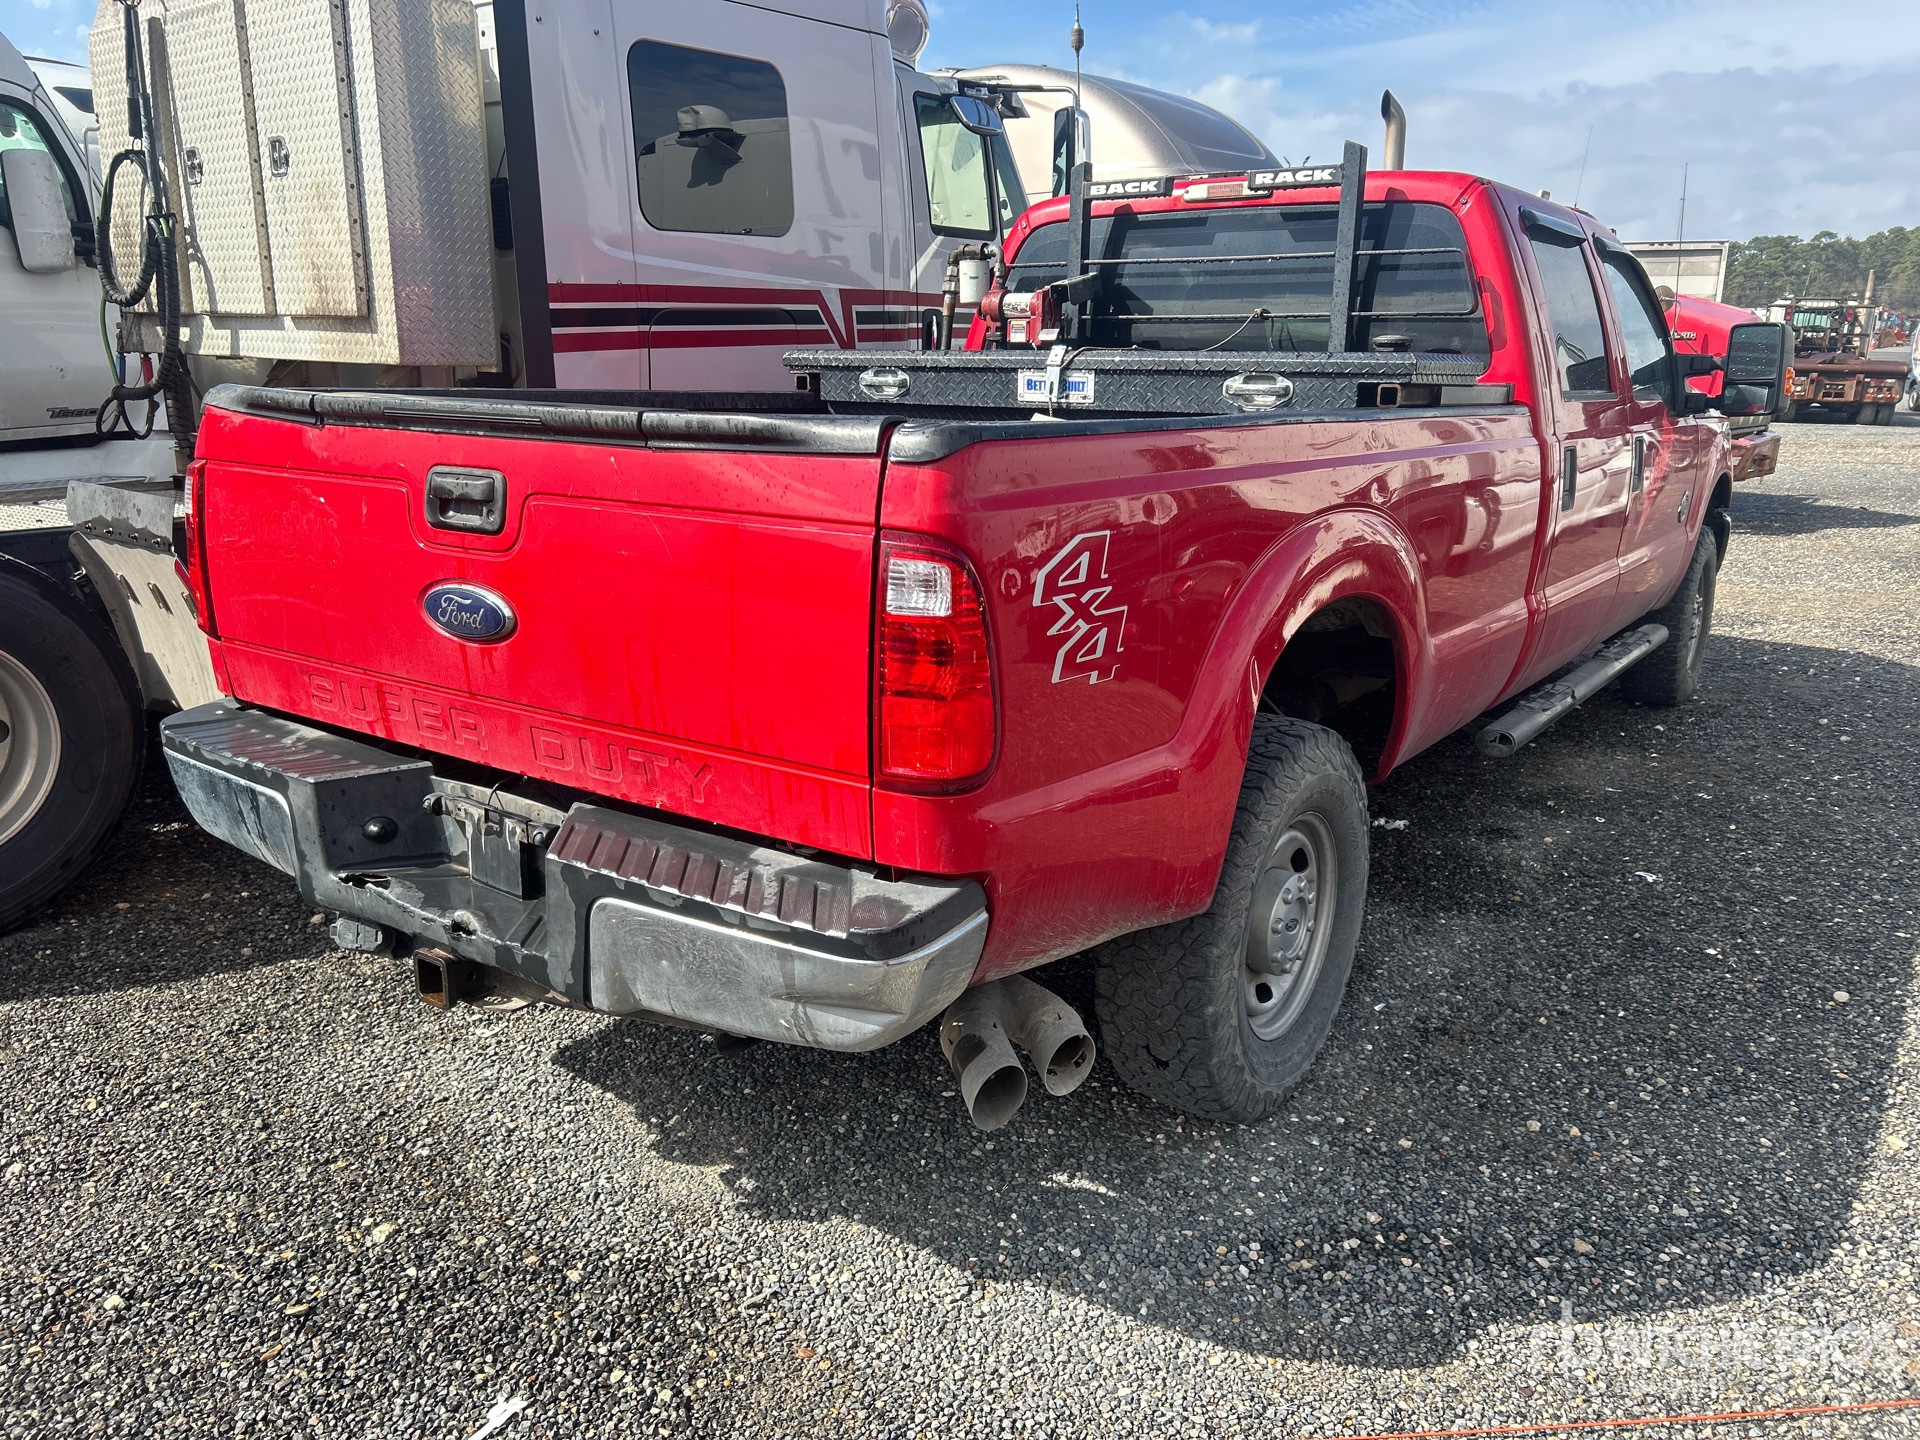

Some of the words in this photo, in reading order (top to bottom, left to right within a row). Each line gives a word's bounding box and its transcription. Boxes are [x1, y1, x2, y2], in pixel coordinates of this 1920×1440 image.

[1090, 181, 1158, 196] BACK
[1255, 168, 1335, 185] RACK
[438, 594, 485, 628] Ford
[308, 672, 489, 752] SUPER
[529, 724, 715, 804] DUTY
